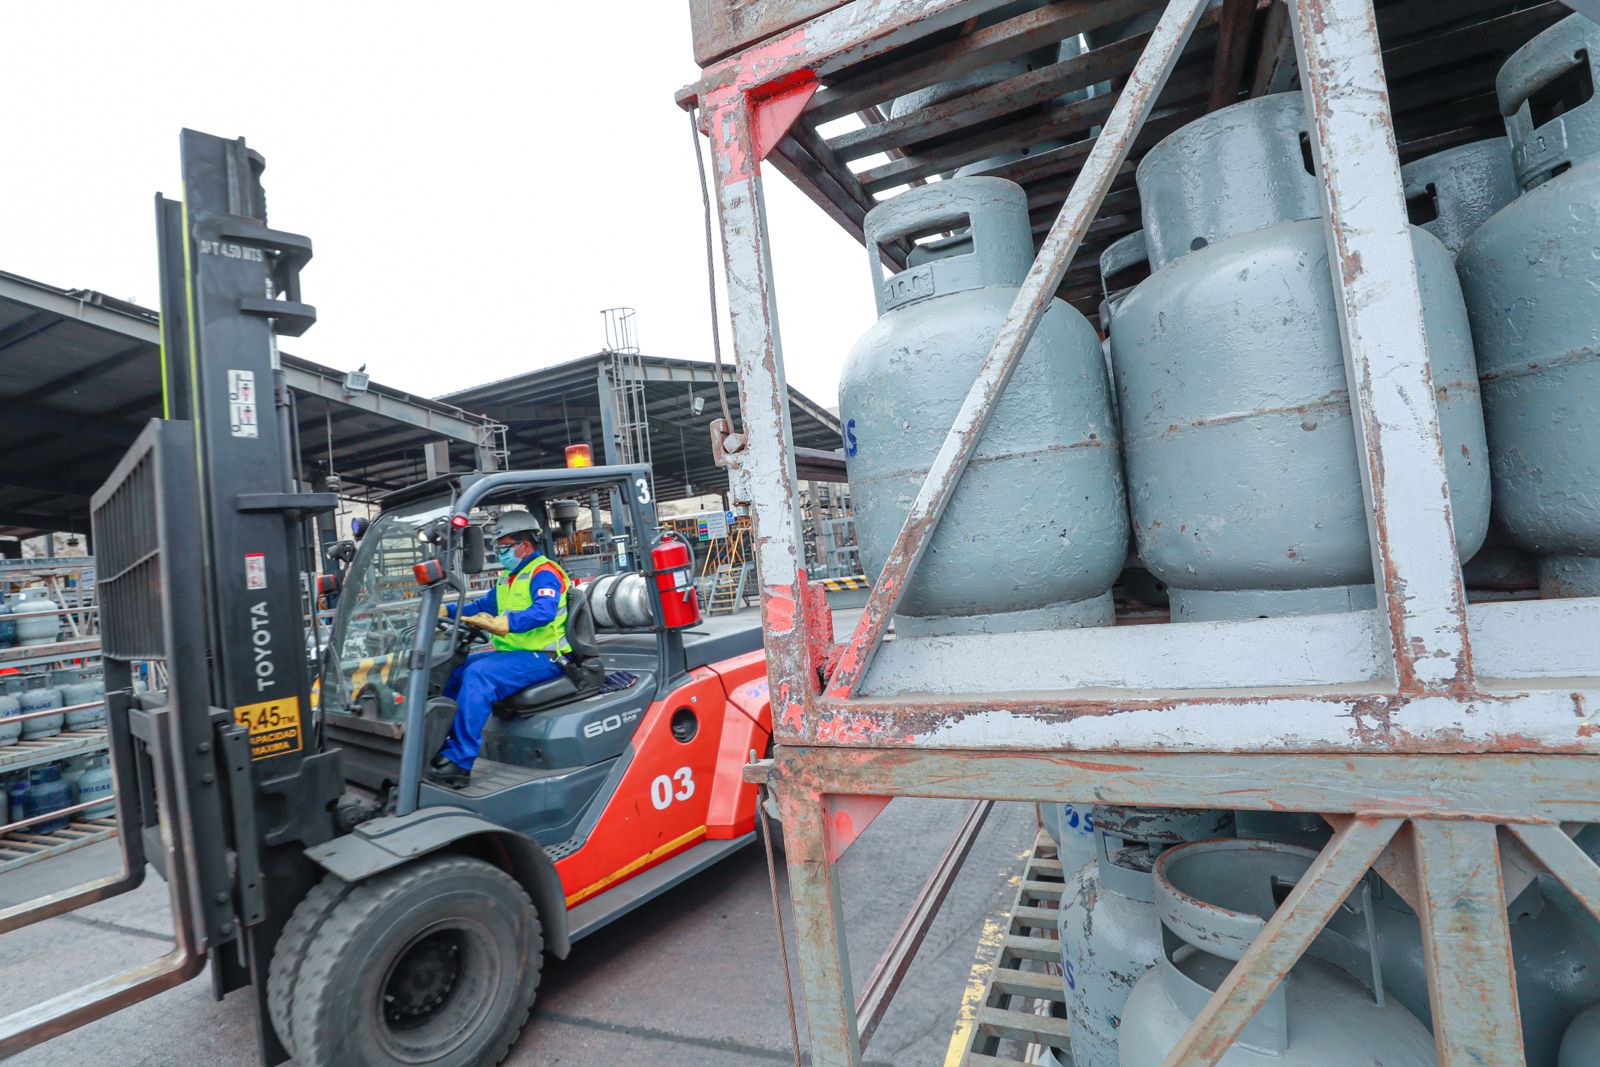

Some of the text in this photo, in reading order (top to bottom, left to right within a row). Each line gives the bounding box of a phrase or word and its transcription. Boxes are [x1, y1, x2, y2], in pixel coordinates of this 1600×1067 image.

[636, 479, 650, 504] 3
[250, 601, 275, 691] TOYOTA
[240, 706, 280, 730] 5.45
[583, 714, 621, 738] 60
[651, 766, 695, 810] 03
